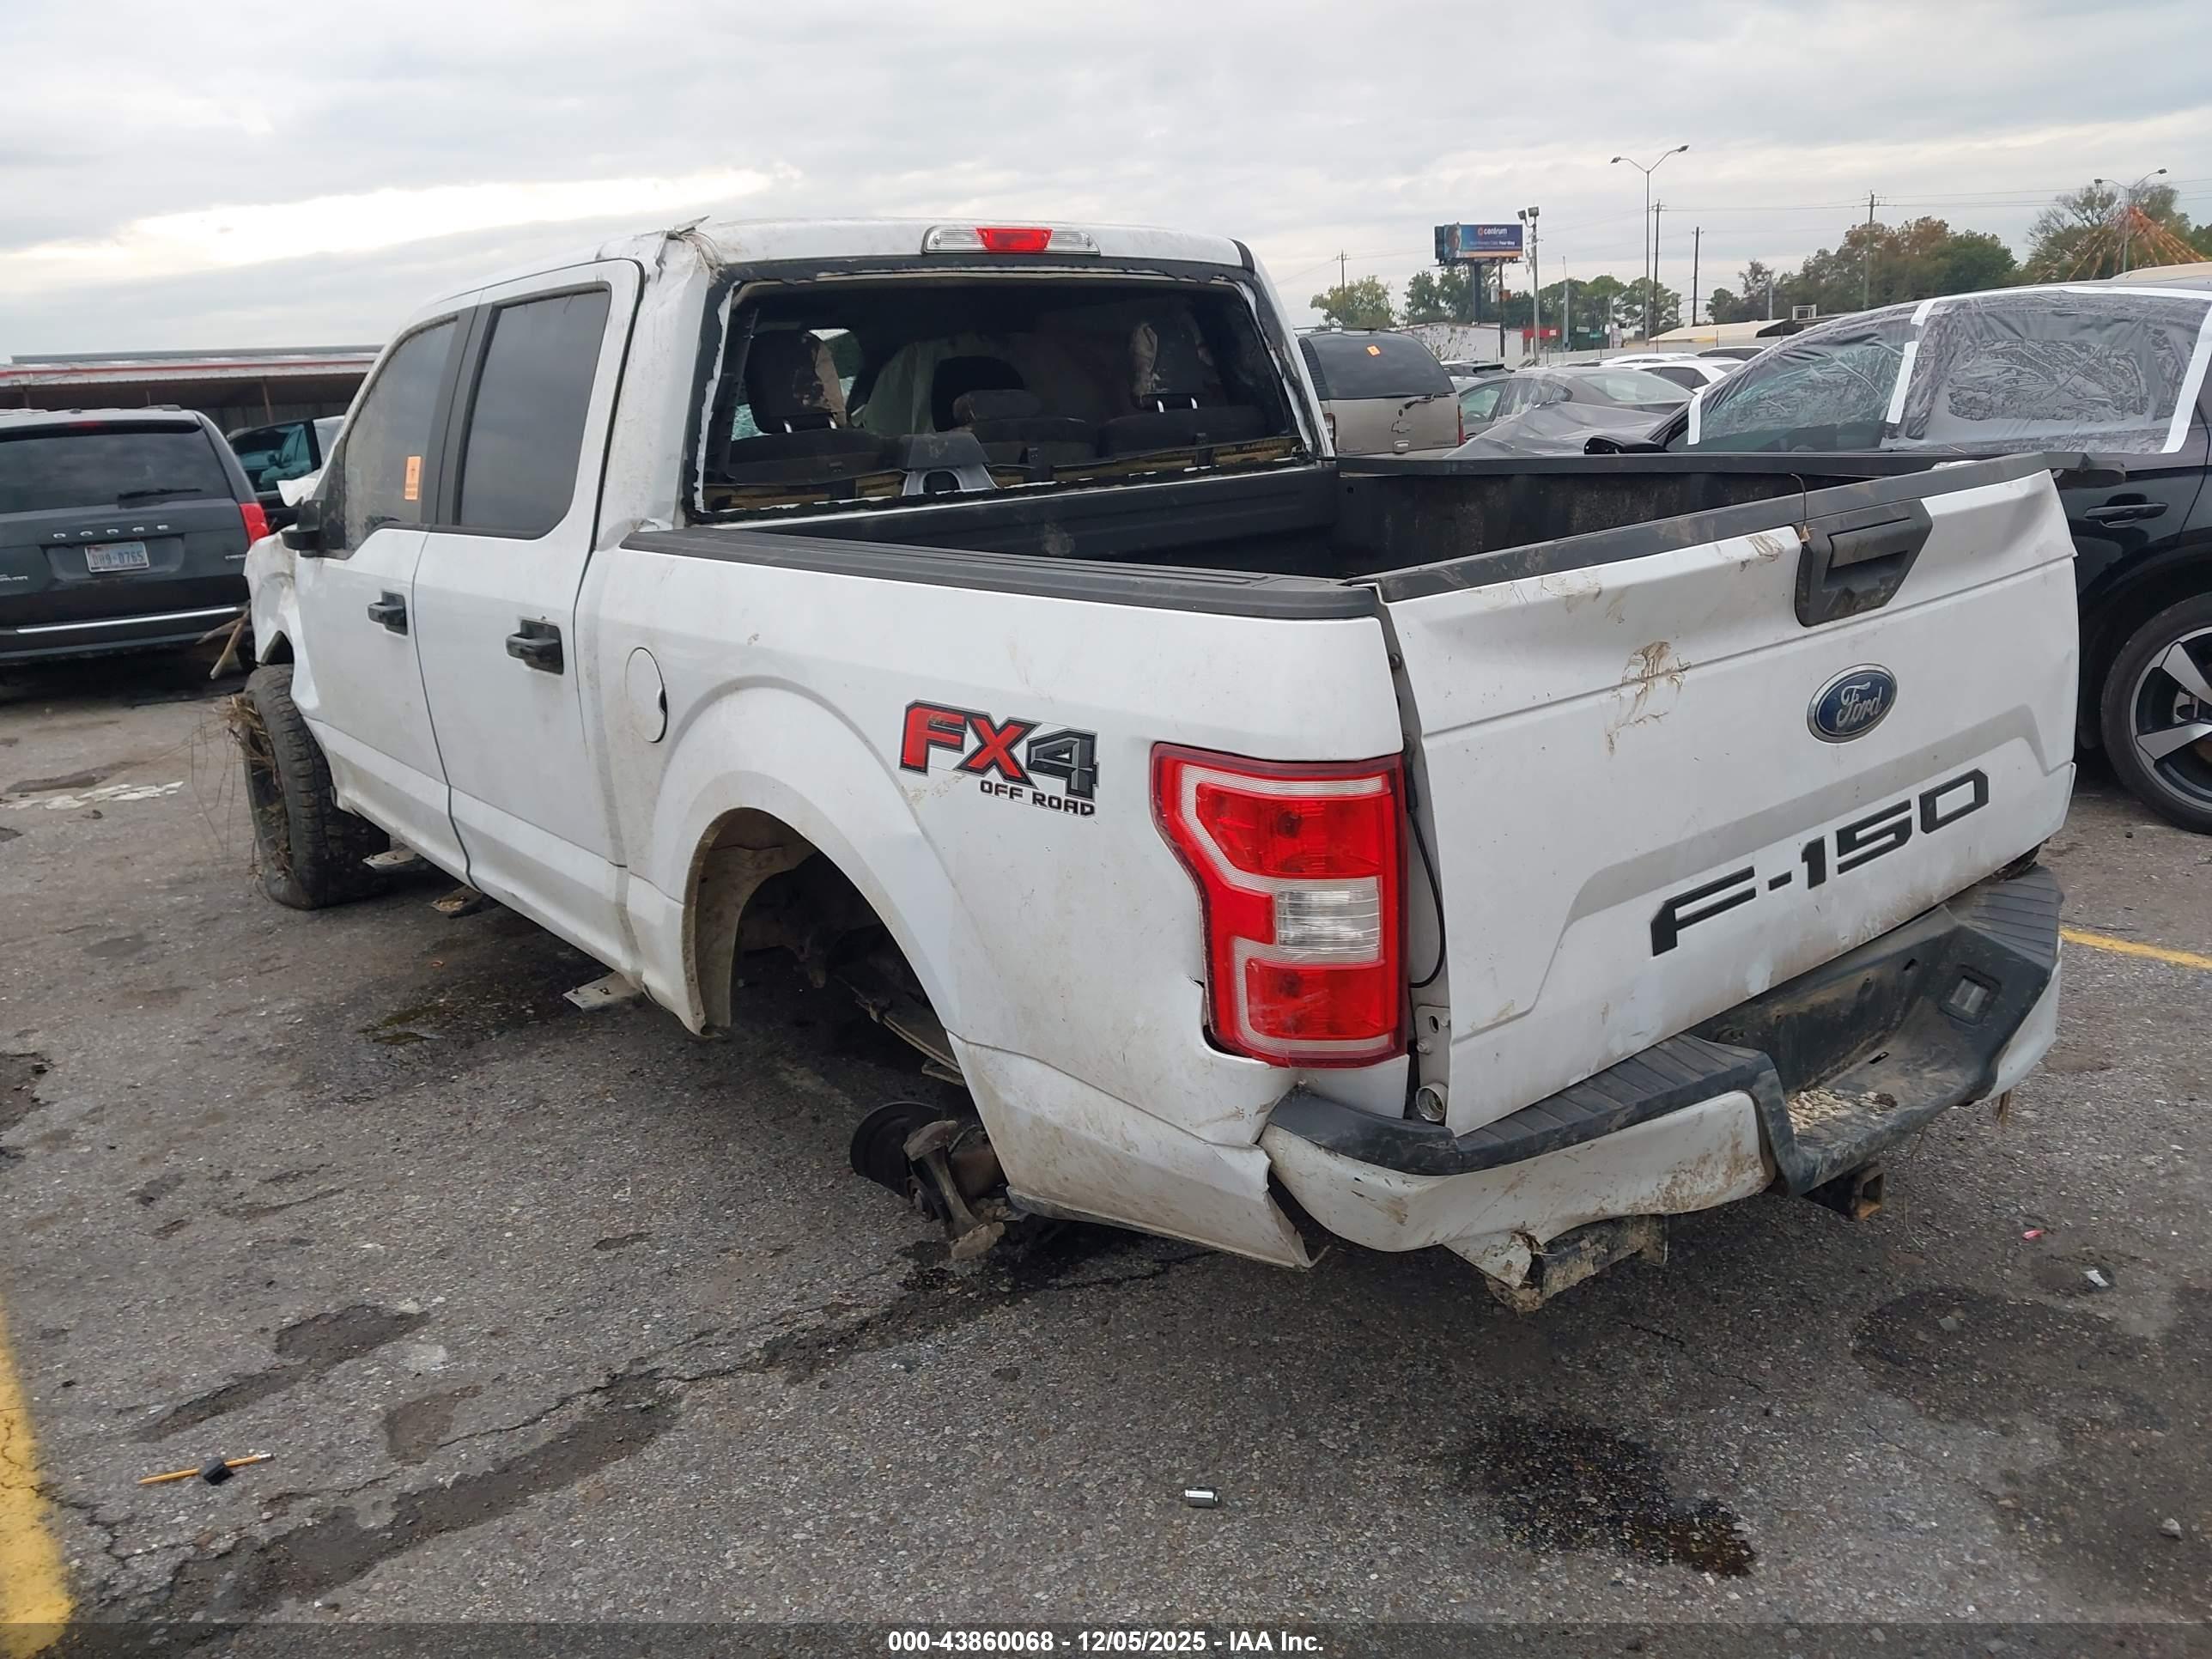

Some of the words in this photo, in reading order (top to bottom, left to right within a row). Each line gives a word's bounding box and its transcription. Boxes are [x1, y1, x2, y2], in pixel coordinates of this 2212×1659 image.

[1836, 682, 1882, 727] Ford
[899, 699, 1099, 803] FX4
[980, 779, 1024, 799] OFF
[1031, 789, 1096, 817] ROAD
[1650, 768, 1990, 957] F-150
